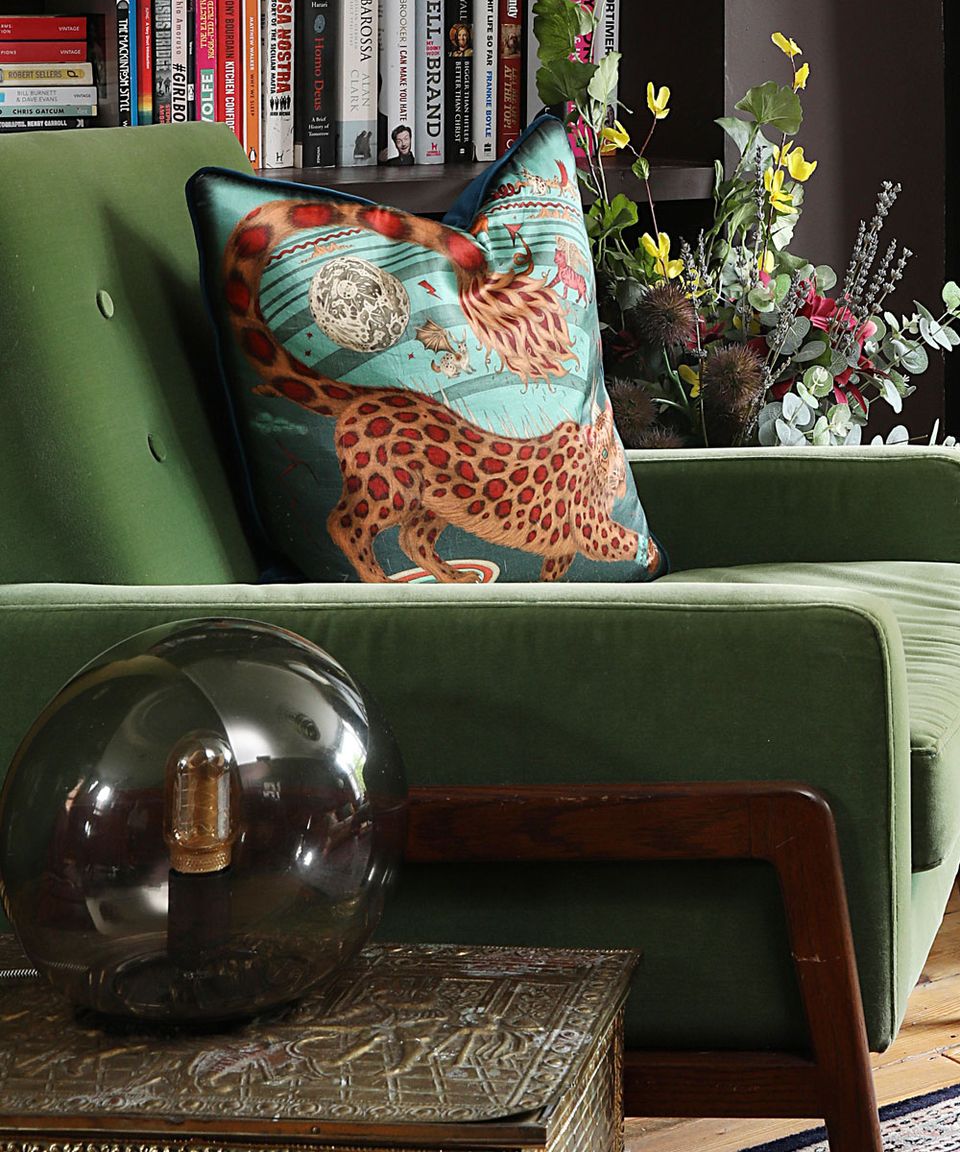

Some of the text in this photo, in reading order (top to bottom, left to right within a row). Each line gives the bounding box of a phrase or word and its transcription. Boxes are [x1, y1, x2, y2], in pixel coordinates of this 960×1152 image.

[175, 18, 183, 56] Amoruso
[225, 18, 234, 59] BOURDAIN
[486, 15, 494, 32] LIFE
[154, 30, 171, 72] BRIDGE
[399, 50, 408, 65] CAN
[486, 35, 493, 47] SO
[8, 69, 63, 79] ROBERT SELLERS
[118, 18, 130, 112] THE MACKINTOSH STYLE
[225, 61, 235, 95] KITCHEN
[276, 28, 292, 94] NOSTRA
[313, 36, 325, 111] Homo Deus
[399, 66, 408, 87] MAKE
[350, 69, 360, 113] CLARK
[361, 73, 371, 107] ALAN
[399, 88, 408, 103] YOU
[426, 56, 441, 138] BRAND
[485, 70, 493, 107] FRANKIE
[503, 64, 512, 129] AT THE TOP!
[308, 123, 323, 131] History
[399, 103, 408, 122] HATE
[454, 113, 462, 143] CHRIST
